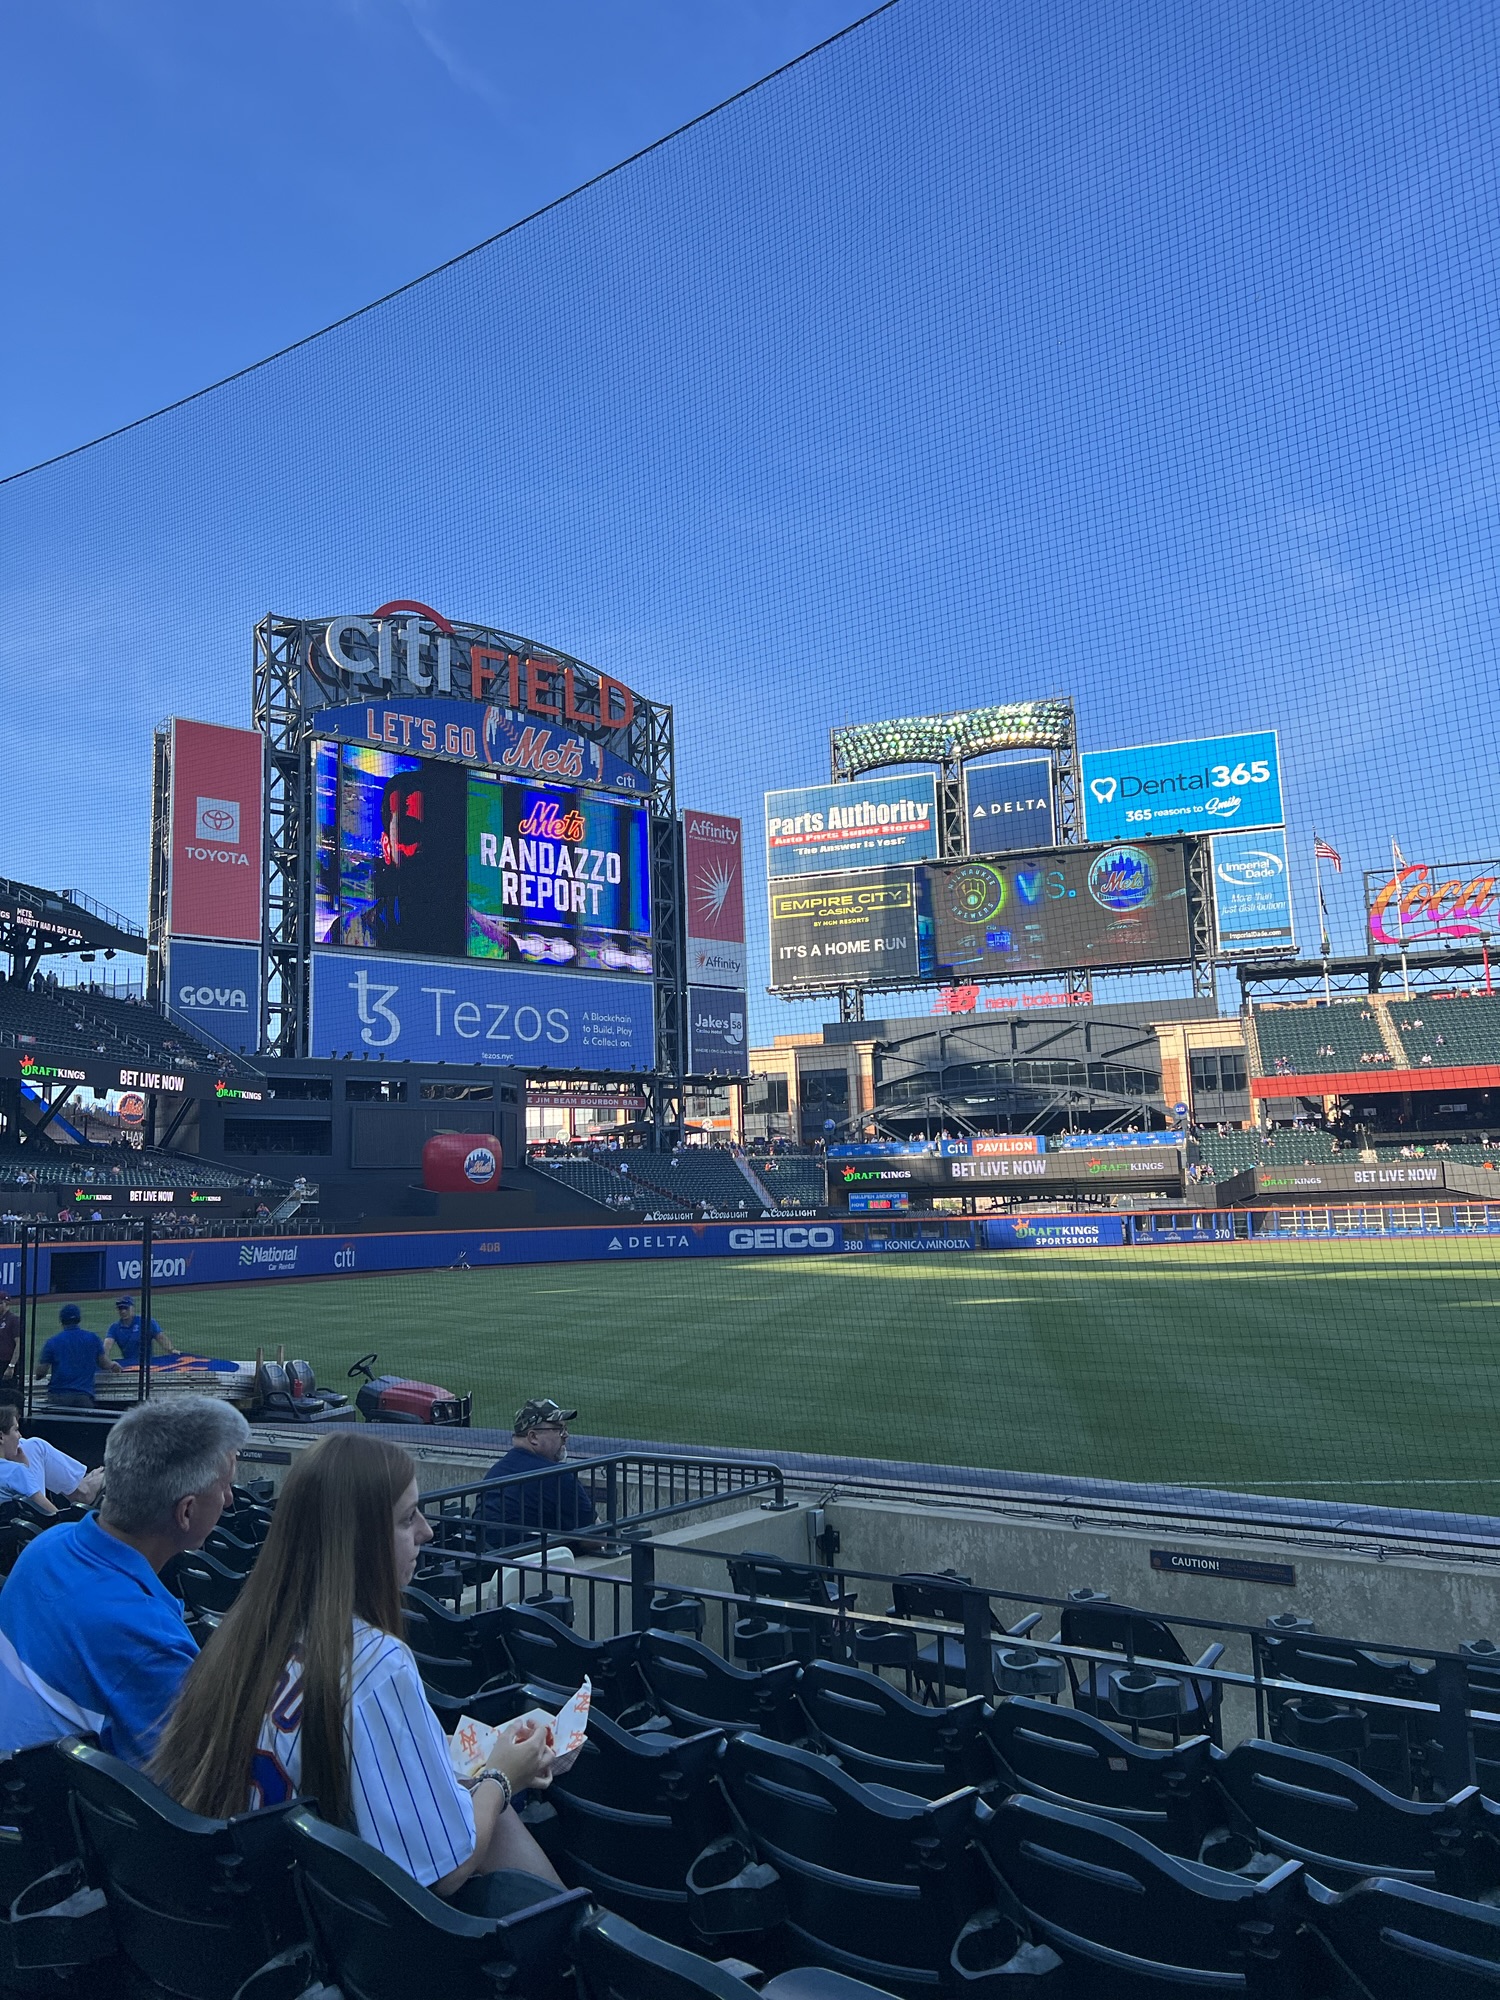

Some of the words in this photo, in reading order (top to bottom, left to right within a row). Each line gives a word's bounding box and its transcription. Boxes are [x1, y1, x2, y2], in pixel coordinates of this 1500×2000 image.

[471, 646, 634, 729] FIELD
[367, 708, 436, 750] LET'S
[445, 723, 476, 757] GO
[503, 726, 583, 778] Mets
[991, 799, 1047, 814] DELTA
[1126, 809, 1152, 822] 365
[1154, 806, 1191, 818] reasons
[1192, 805, 1204, 813] to
[1205, 796, 1241, 817] Smile
[519, 801, 585, 841] Mets
[769, 811, 824, 837] Parts
[828, 800, 929, 830] Authority
[689, 819, 738, 845] Affinity
[775, 836, 803, 845] Auto
[805, 832, 839, 842] Parts
[841, 828, 880, 838] Super
[819, 842, 861, 853] Answer
[185, 847, 250, 867] TOYOTA
[480, 832, 621, 885] RANDAZZO
[1226, 859, 1270, 872] Imperial
[1245, 867, 1275, 879] Dade
[1101, 871, 1144, 893] Mets
[502, 870, 604, 915] REPORT
[1231, 893, 1252, 903] More
[780, 895, 853, 911] EMPIRE
[818, 906, 864, 917] CASINO
[839, 917, 870, 925] RESORTS
[52, 924, 56, 932] A
[780, 945, 808, 960] IT'S
[811, 945, 821, 957] A
[825, 940, 871, 956] HOME
[875, 937, 907, 951] RUN
[705, 955, 741, 973] Affinity
[179, 985, 248, 1007] GOYA
[985, 997, 1018, 1009] new
[1022, 991, 1093, 1007] balance
[421, 988, 570, 1043] Tezos
[582, 1011, 589, 1020] A
[591, 1012, 632, 1023] Blockchain
[695, 1013, 729, 1029] Jake's
[731, 1020, 742, 1030] 58
[582, 1025, 591, 1033] to
[616, 1026, 633, 1037] Play
[582, 1036, 589, 1045] &
[591, 1036, 618, 1046] Collect
[481, 1051, 514, 1060] tezos.nyc
[21, 1065, 86, 1080] DRAFTKINGS
[120, 1069, 138, 1086] BET
[140, 1072, 160, 1089] LIVE
[162, 1075, 185, 1091] NOW
[216, 1089, 262, 1100] DRAFTKINGS
[947, 1143, 968, 1154] citi
[976, 1141, 1033, 1153] PAVILION
[952, 1162, 976, 1177] BET
[980, 1161, 1009, 1176] LIVE
[1012, 1160, 1047, 1175] NOW
[1090, 1162, 1165, 1174] DRAFTKINGS
[844, 1171, 912, 1182] DRAFTKINGS
[1262, 1177, 1322, 1187] DRAFTKINGS
[1354, 1170, 1377, 1183] BET
[1379, 1169, 1405, 1182] LIVE
[1408, 1168, 1438, 1181] NOW
[129, 1190, 142, 1201] BET
[143, 1191, 157, 1201] LIVE
[158, 1191, 174, 1202] NOW
[652, 1210, 675, 1221] Coors
[674, 1212, 694, 1220] LIGHT
[710, 1209, 730, 1220] Coors
[730, 1211, 749, 1219] LIGHT
[769, 1207, 795, 1218] Coors
[795, 1209, 817, 1217] LIGHT
[729, 1227, 835, 1250] GEICO
[1015, 1226, 1099, 1239] DRAFTKINGS
[1215, 1228, 1230, 1239] 370
[479, 1242, 501, 1252] 408
[628, 1235, 690, 1248] DELTA
[844, 1240, 863, 1251] 380
[884, 1240, 925, 1250] KONICA
[926, 1239, 971, 1249] MINOLTA
[1035, 1236, 1099, 1245] SPORTSBOOK
[253, 1245, 299, 1263] National
[334, 1247, 355, 1268] citi
[118, 1254, 186, 1280] veizon
[268, 1263, 277, 1271] Car
[1171, 1556, 1220, 1570] CAUTION!
